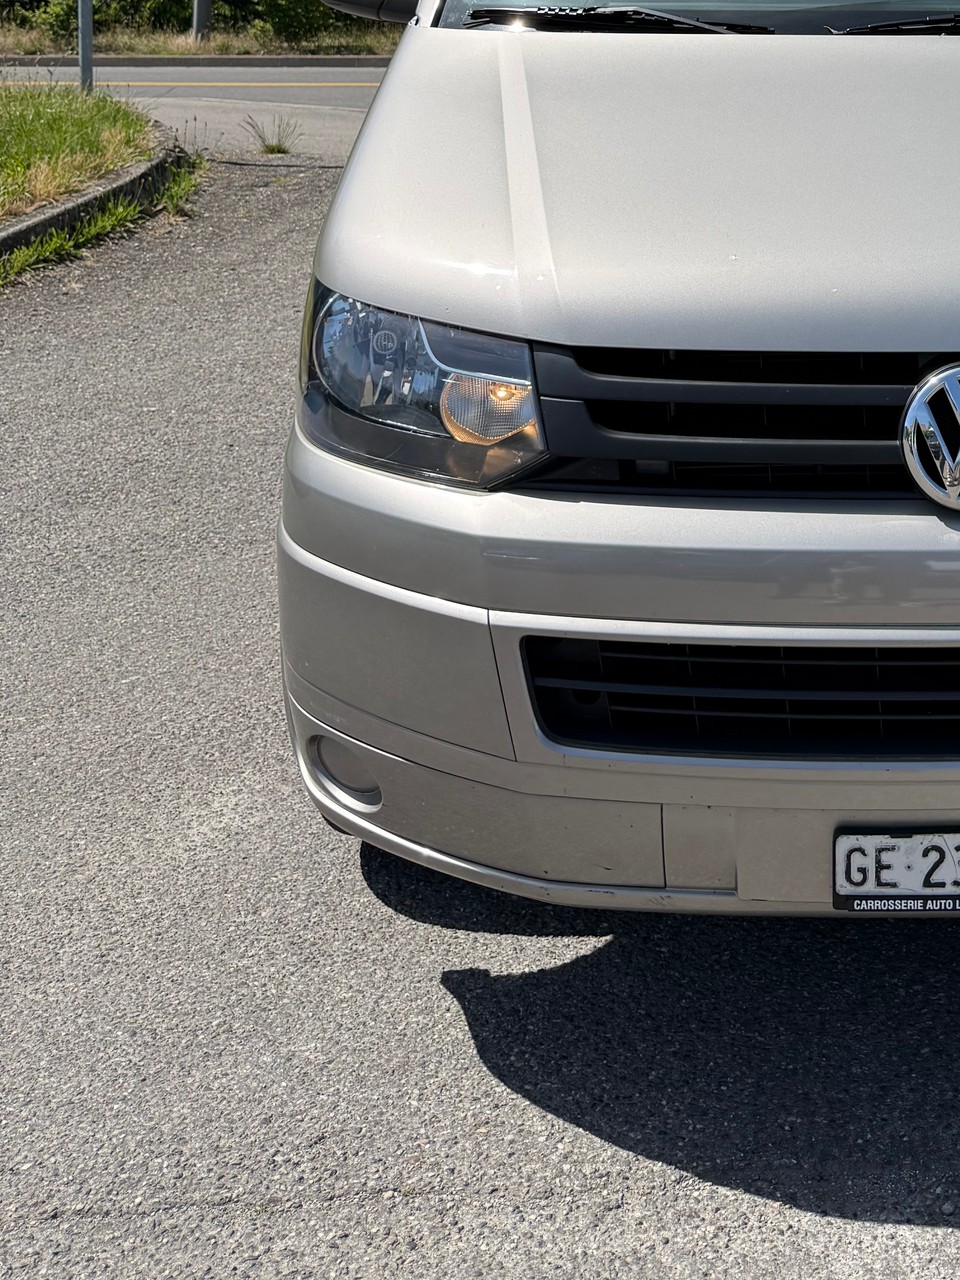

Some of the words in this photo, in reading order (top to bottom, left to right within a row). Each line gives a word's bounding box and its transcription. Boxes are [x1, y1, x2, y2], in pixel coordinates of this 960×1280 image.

[844, 845, 900, 888] GE
[854, 900, 924, 910] CARROSSERIE
[926, 900, 953, 909] AUTO
